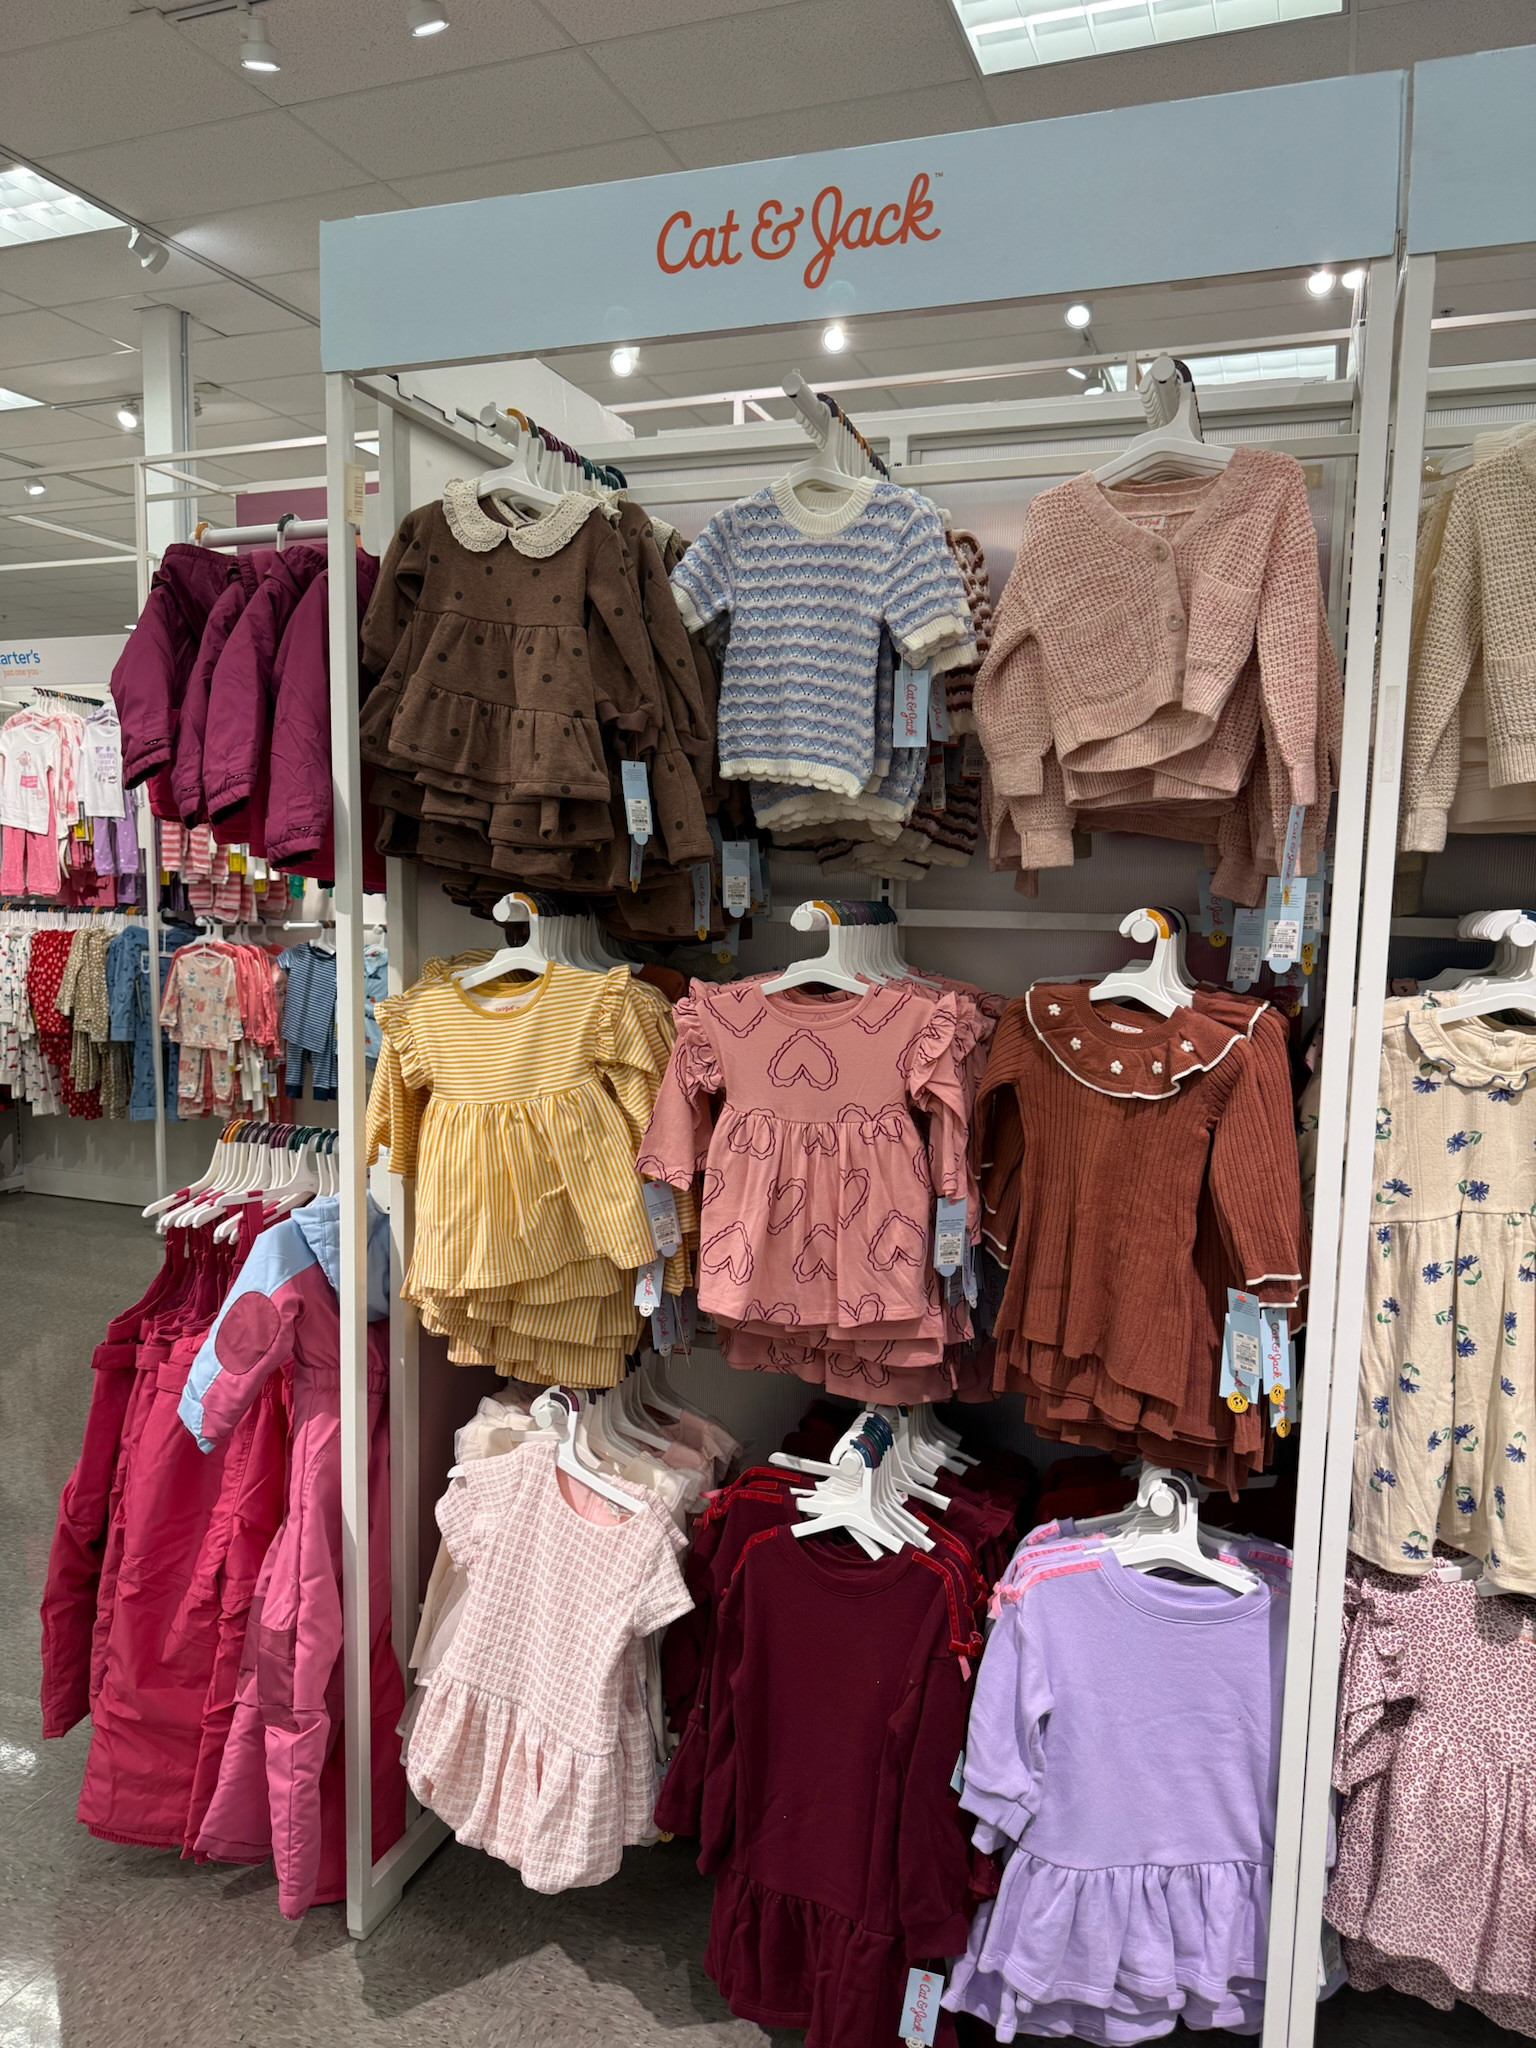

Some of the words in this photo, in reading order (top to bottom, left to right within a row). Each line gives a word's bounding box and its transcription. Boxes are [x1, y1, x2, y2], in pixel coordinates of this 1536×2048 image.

[657, 210, 742, 274] Cat
[751, 199, 804, 260] &
[803, 172, 941, 289] Jack
[905, 683, 917, 700] Cat
[905, 702, 917, 713] &
[900, 711, 918, 737] Jack
[642, 1273, 655, 1296] Jack
[1271, 1322, 1280, 1341] Cat
[1272, 1342, 1280, 1352] &
[1268, 1353, 1282, 1380] Jack
[918, 1983, 931, 2000] Cat
[916, 2000, 928, 2012] &
[910, 2006, 927, 2033] Jack
